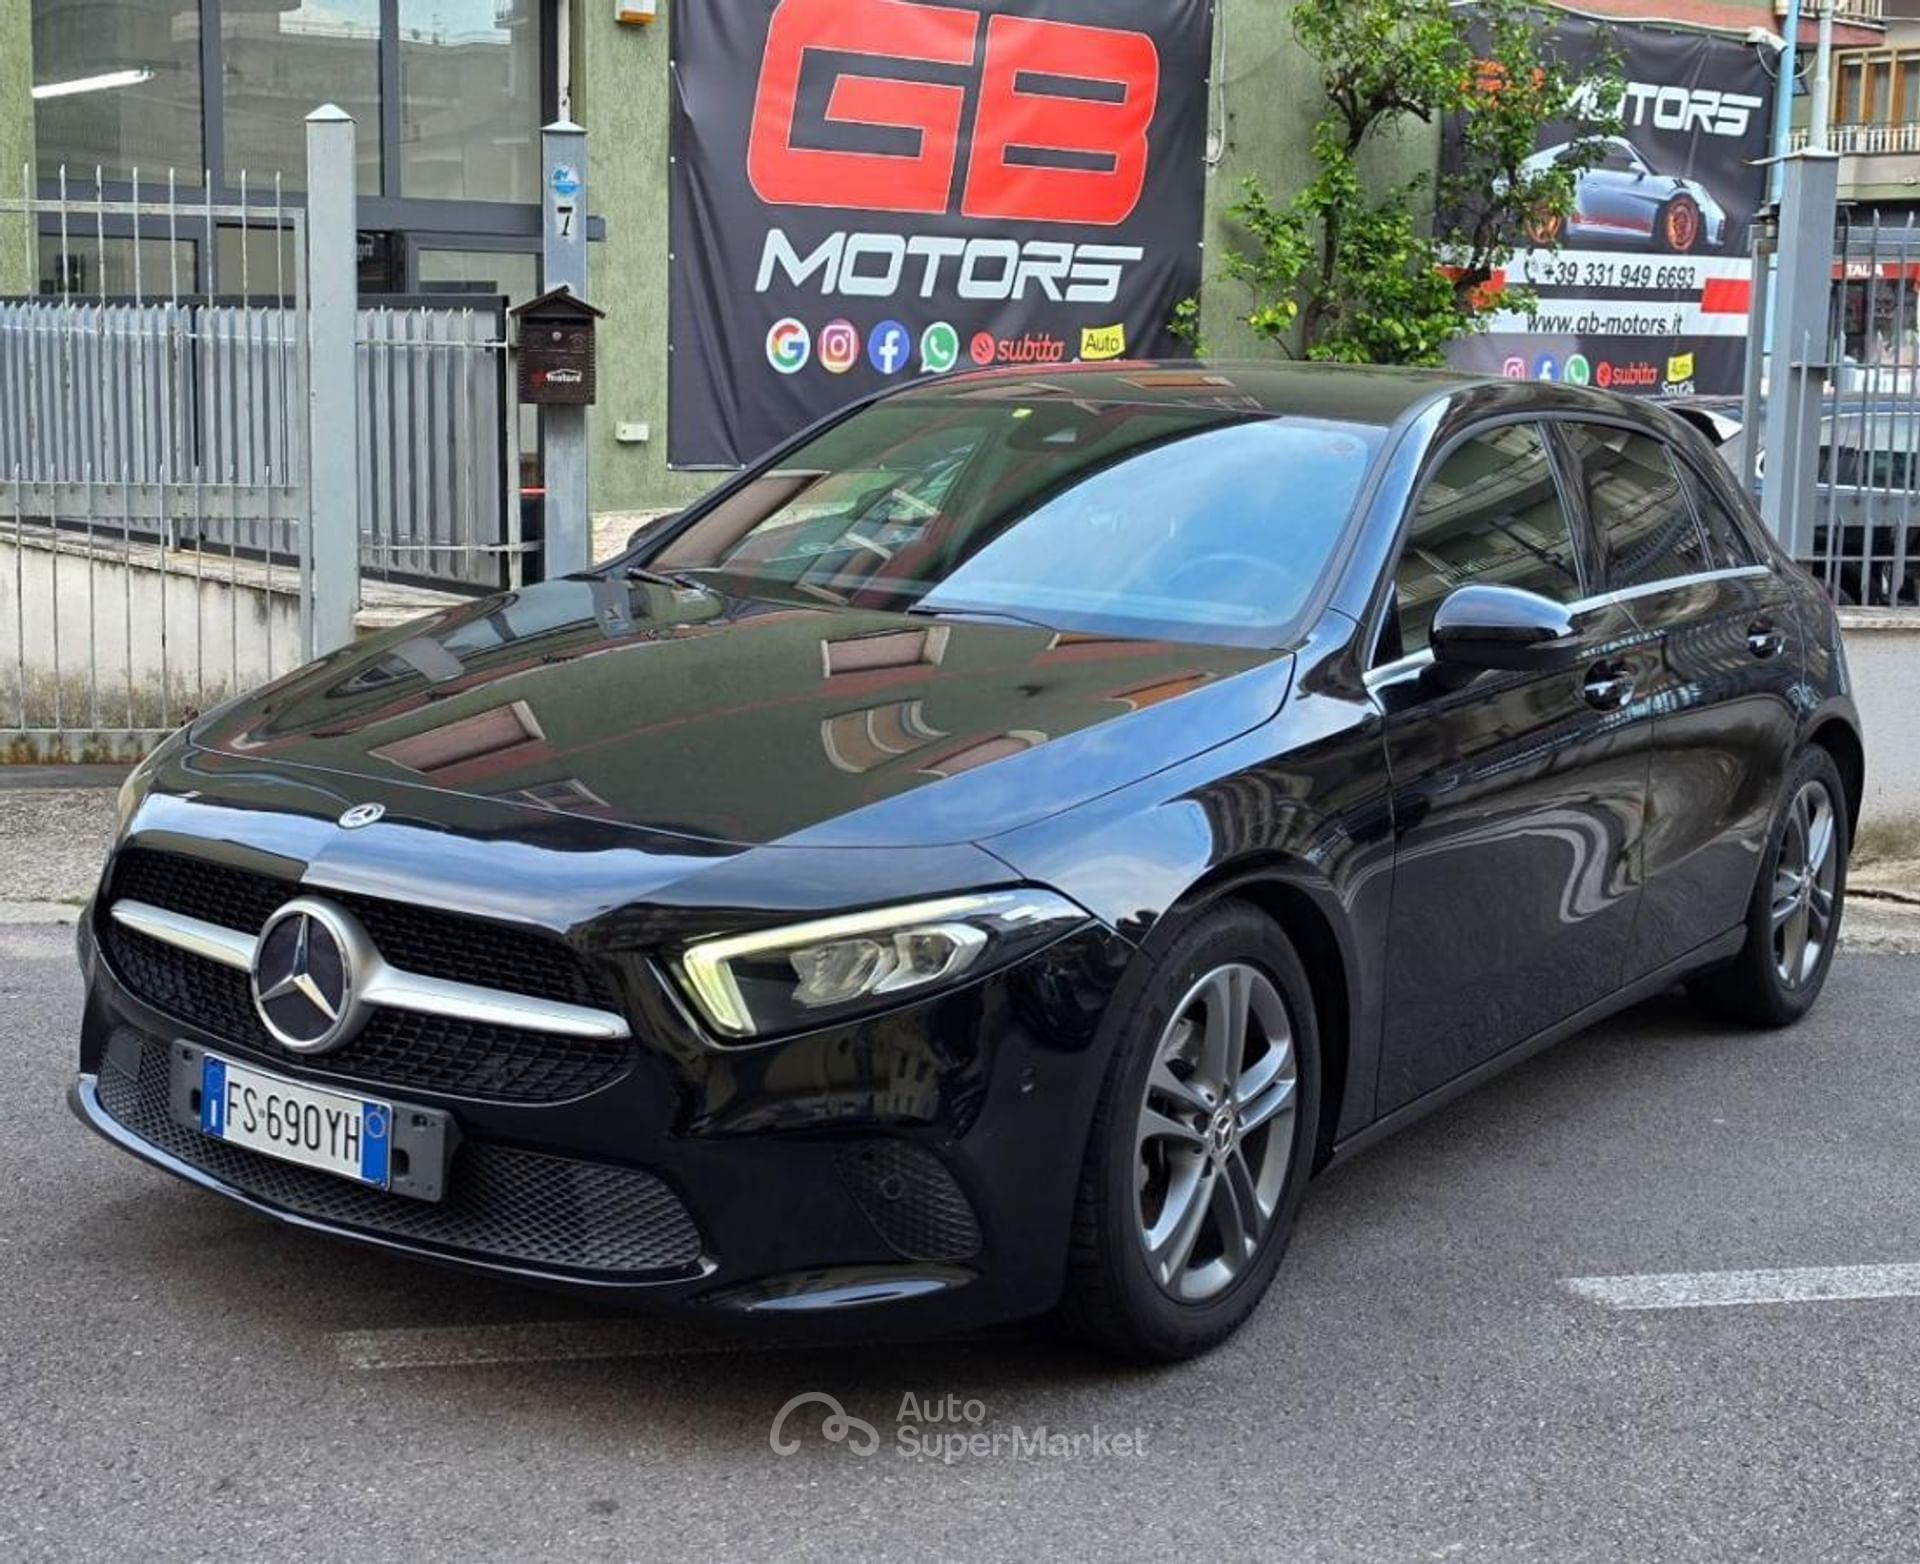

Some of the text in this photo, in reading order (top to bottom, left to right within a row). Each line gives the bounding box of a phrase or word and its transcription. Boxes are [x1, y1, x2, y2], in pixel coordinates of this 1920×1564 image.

[746, 0, 1160, 226] GB
[556, 205, 573, 237] 7
[755, 228, 1144, 302] MOTORS
[1583, 262, 1614, 287] 331
[1619, 264, 1652, 288] 949
[1656, 266, 1696, 289] 6693
[1527, 311, 1684, 335] www.gb-motors.it
[997, 333, 1065, 362] subito
[1084, 333, 1120, 352] Auto
[1612, 362, 1658, 386] subito
